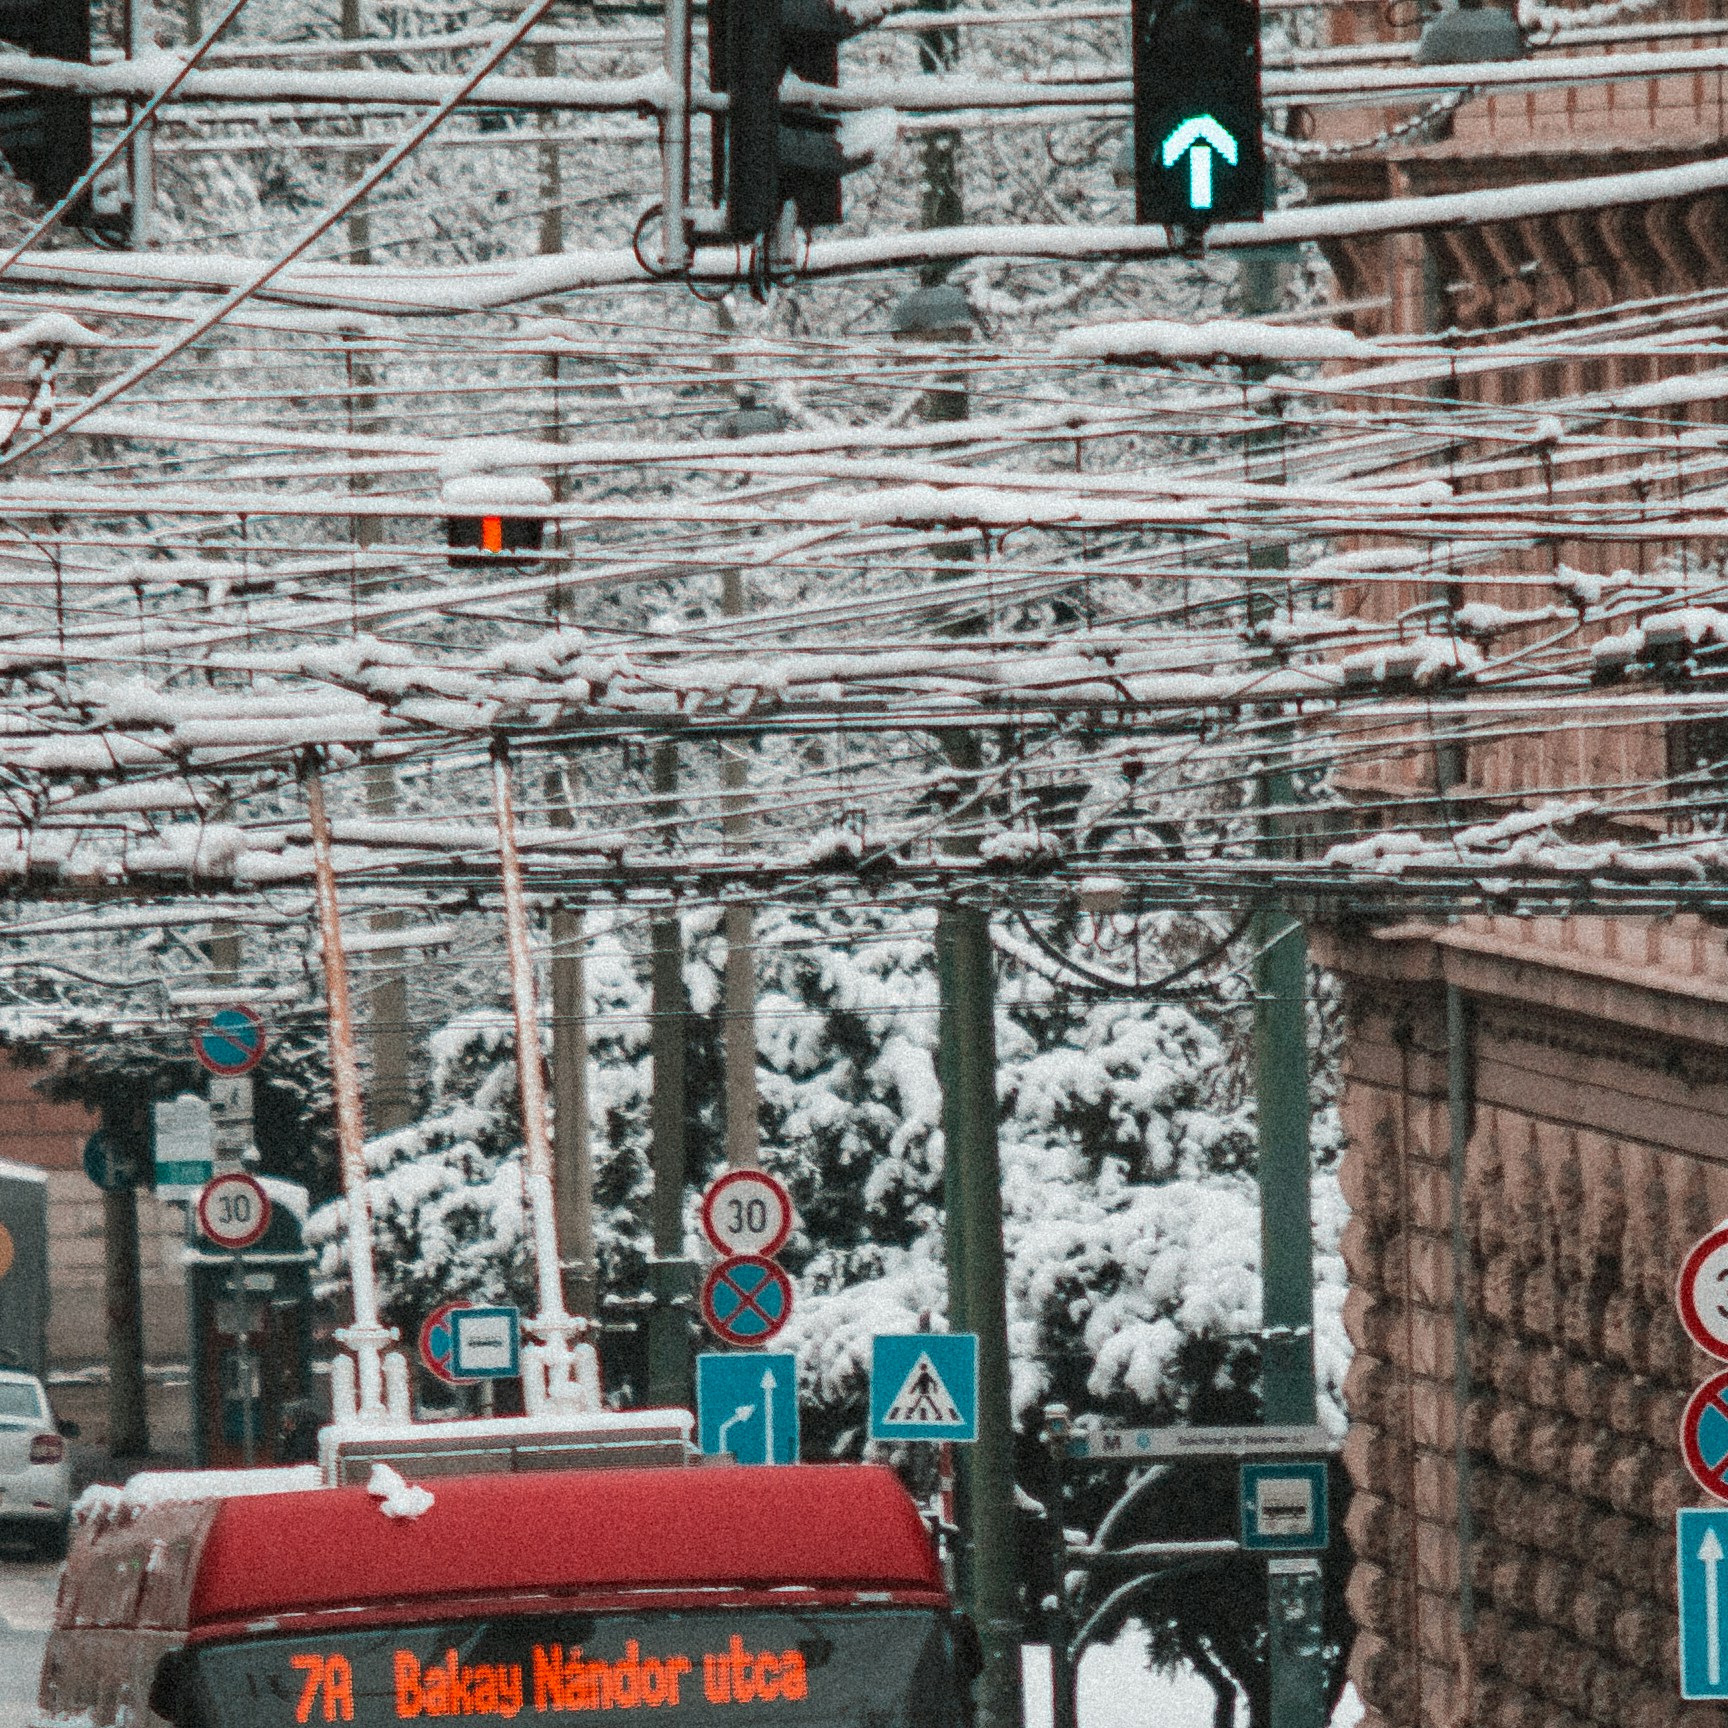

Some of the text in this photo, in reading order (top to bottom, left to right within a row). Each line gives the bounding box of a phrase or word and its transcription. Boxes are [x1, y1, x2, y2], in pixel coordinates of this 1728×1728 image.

[218, 1194, 251, 1224] 30
[727, 1198, 767, 1234] 30
[288, 1633, 810, 1724] 7A Bakay Nándor utca
